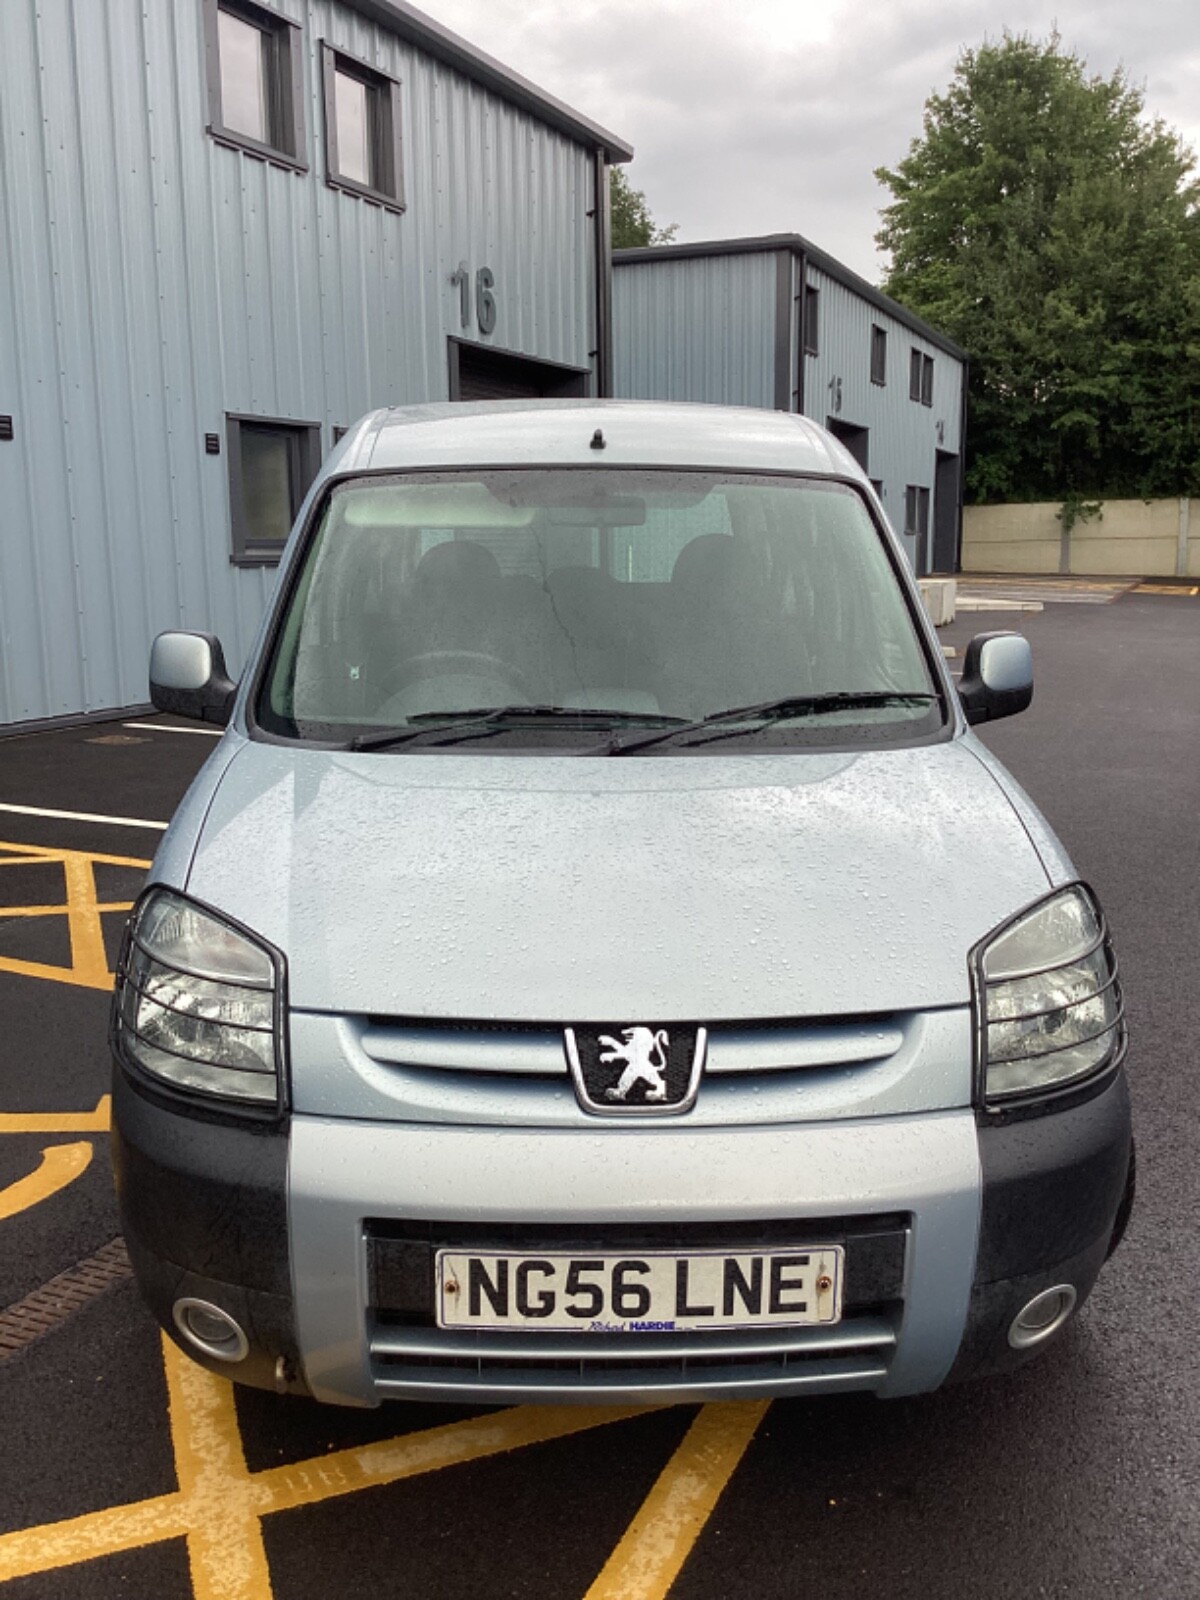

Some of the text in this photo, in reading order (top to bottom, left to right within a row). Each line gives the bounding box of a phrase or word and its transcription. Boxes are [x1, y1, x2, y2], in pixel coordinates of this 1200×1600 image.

[449, 262, 496, 334] 16
[468, 1256, 810, 1318] NG56 LNE
[629, 1321, 675, 1331] HARDIE
